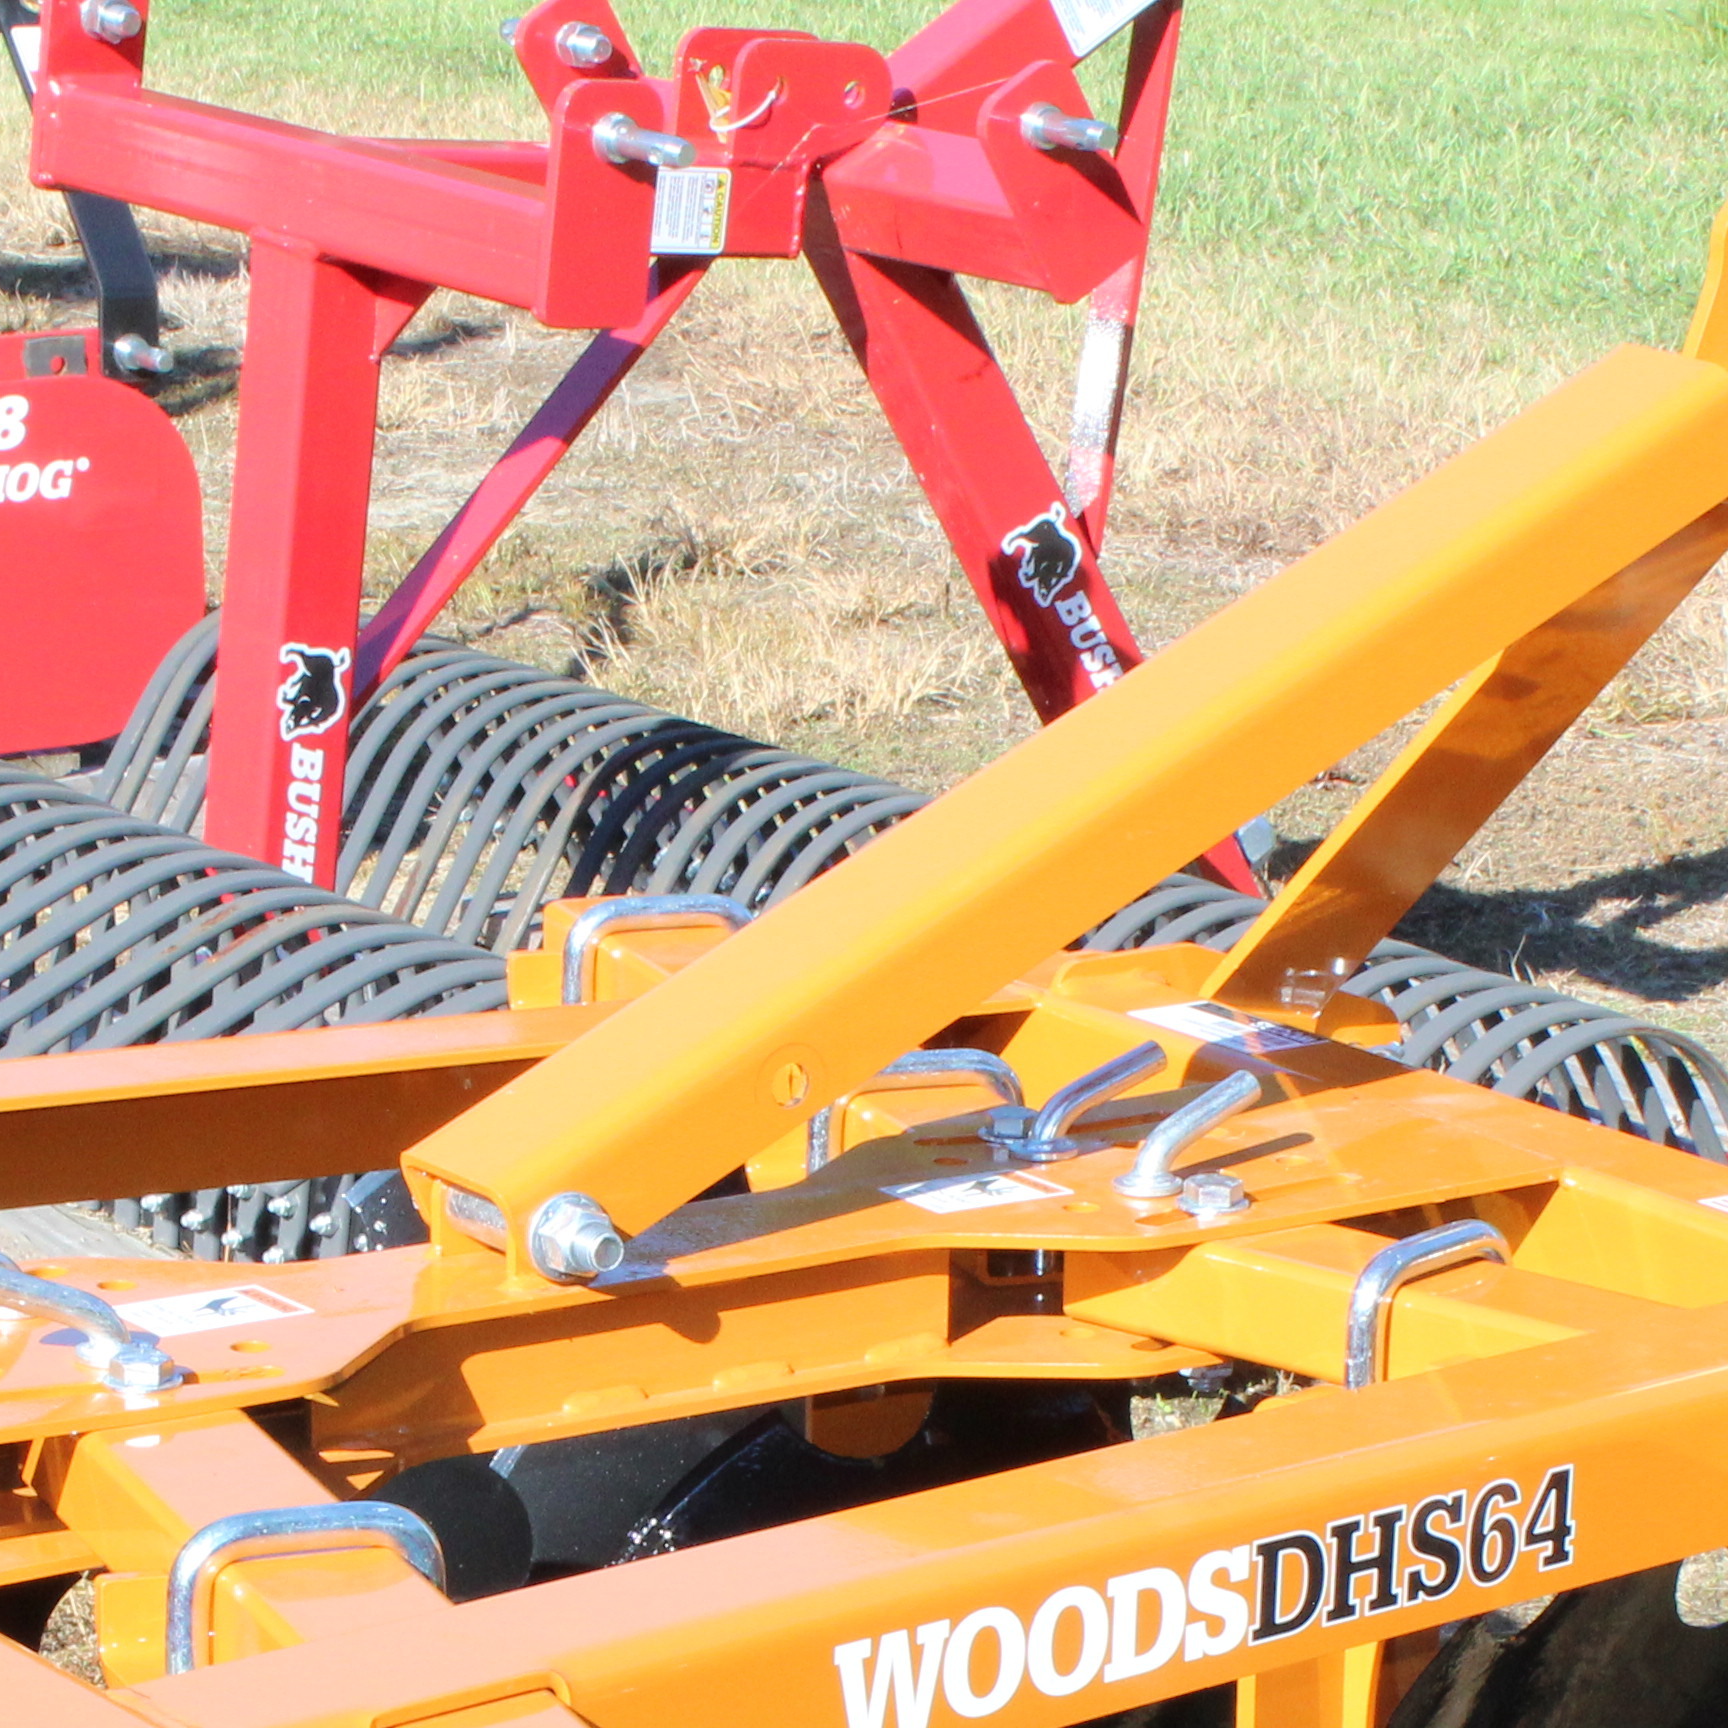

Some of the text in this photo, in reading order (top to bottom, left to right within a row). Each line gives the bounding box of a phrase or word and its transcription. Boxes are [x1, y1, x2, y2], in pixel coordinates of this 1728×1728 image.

[712, 192, 724, 244] CAUTION
[282, 743, 324, 884] BUSH
[1248, 1463, 1576, 1648] DHS64
